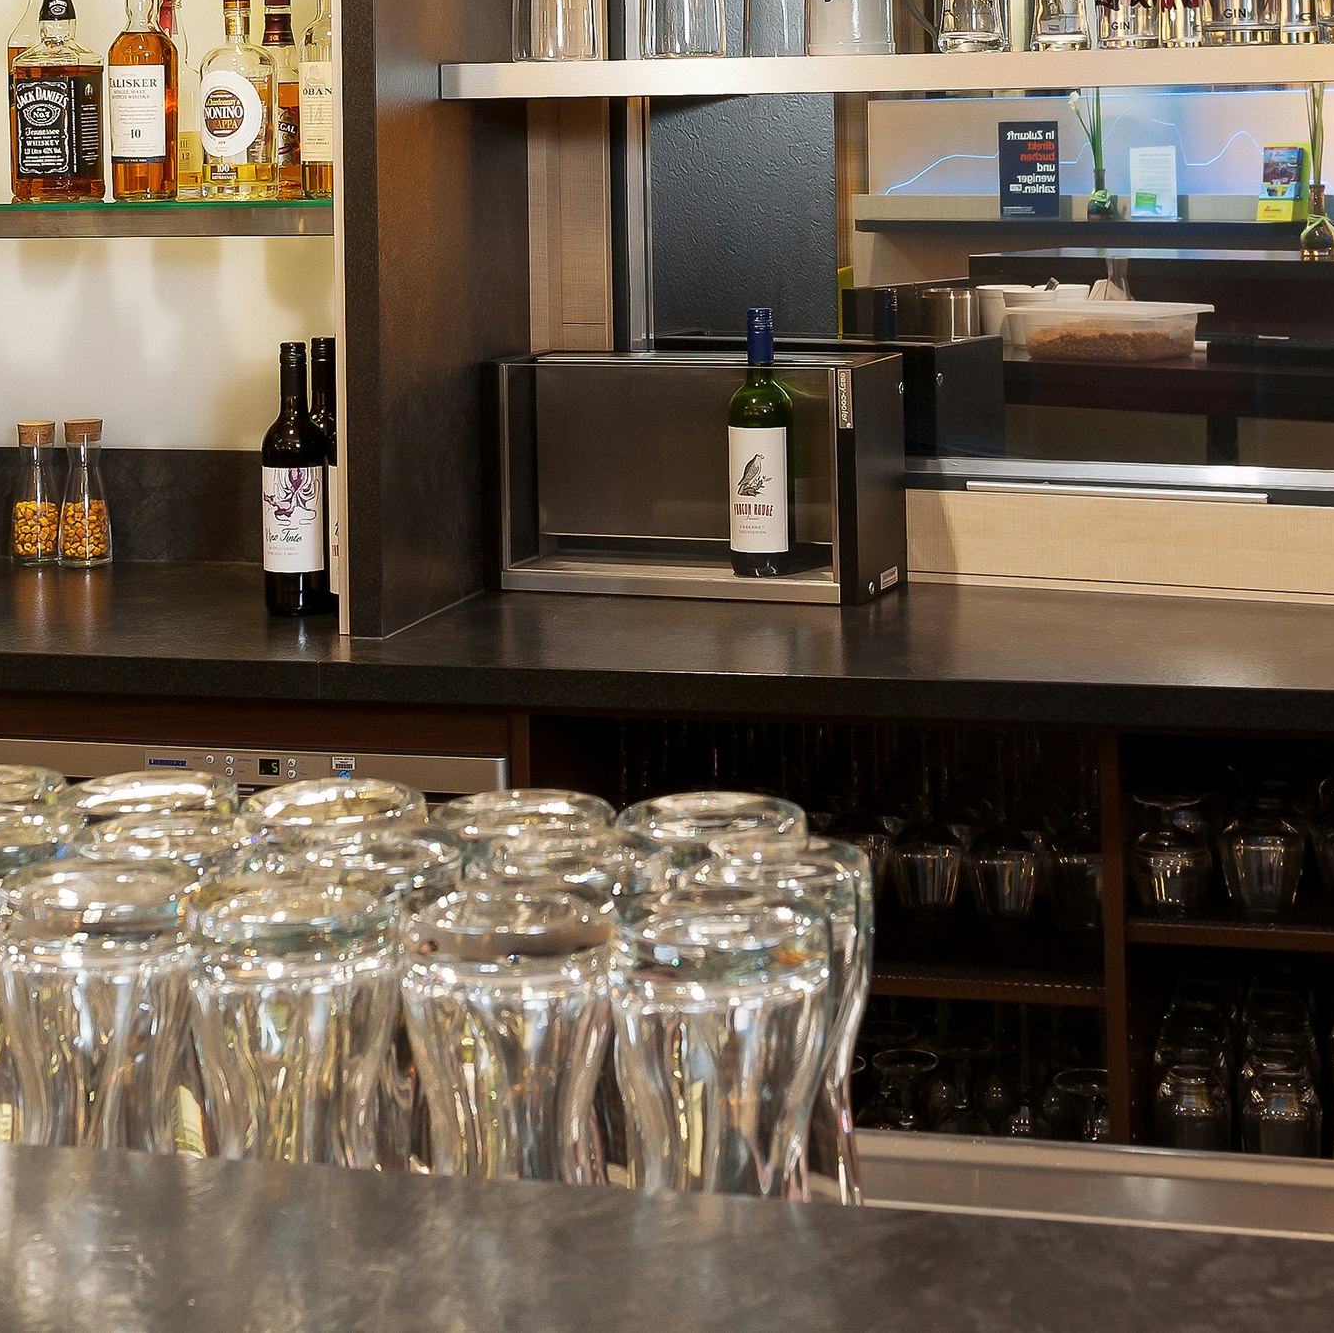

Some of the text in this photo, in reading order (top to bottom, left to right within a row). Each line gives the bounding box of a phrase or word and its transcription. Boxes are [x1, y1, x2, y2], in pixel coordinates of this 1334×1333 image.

[1224, 8, 1246, 18] GIN
[1111, 21, 1130, 30] GIN
[17, 91, 36, 109] JACK
[204, 105, 243, 119] NONINO
[130, 129, 141, 138] 10
[839, 372, 848, 422] easy-cooler
[754, 504, 773, 516] ROUGE
[272, 762, 278, 772] 5
